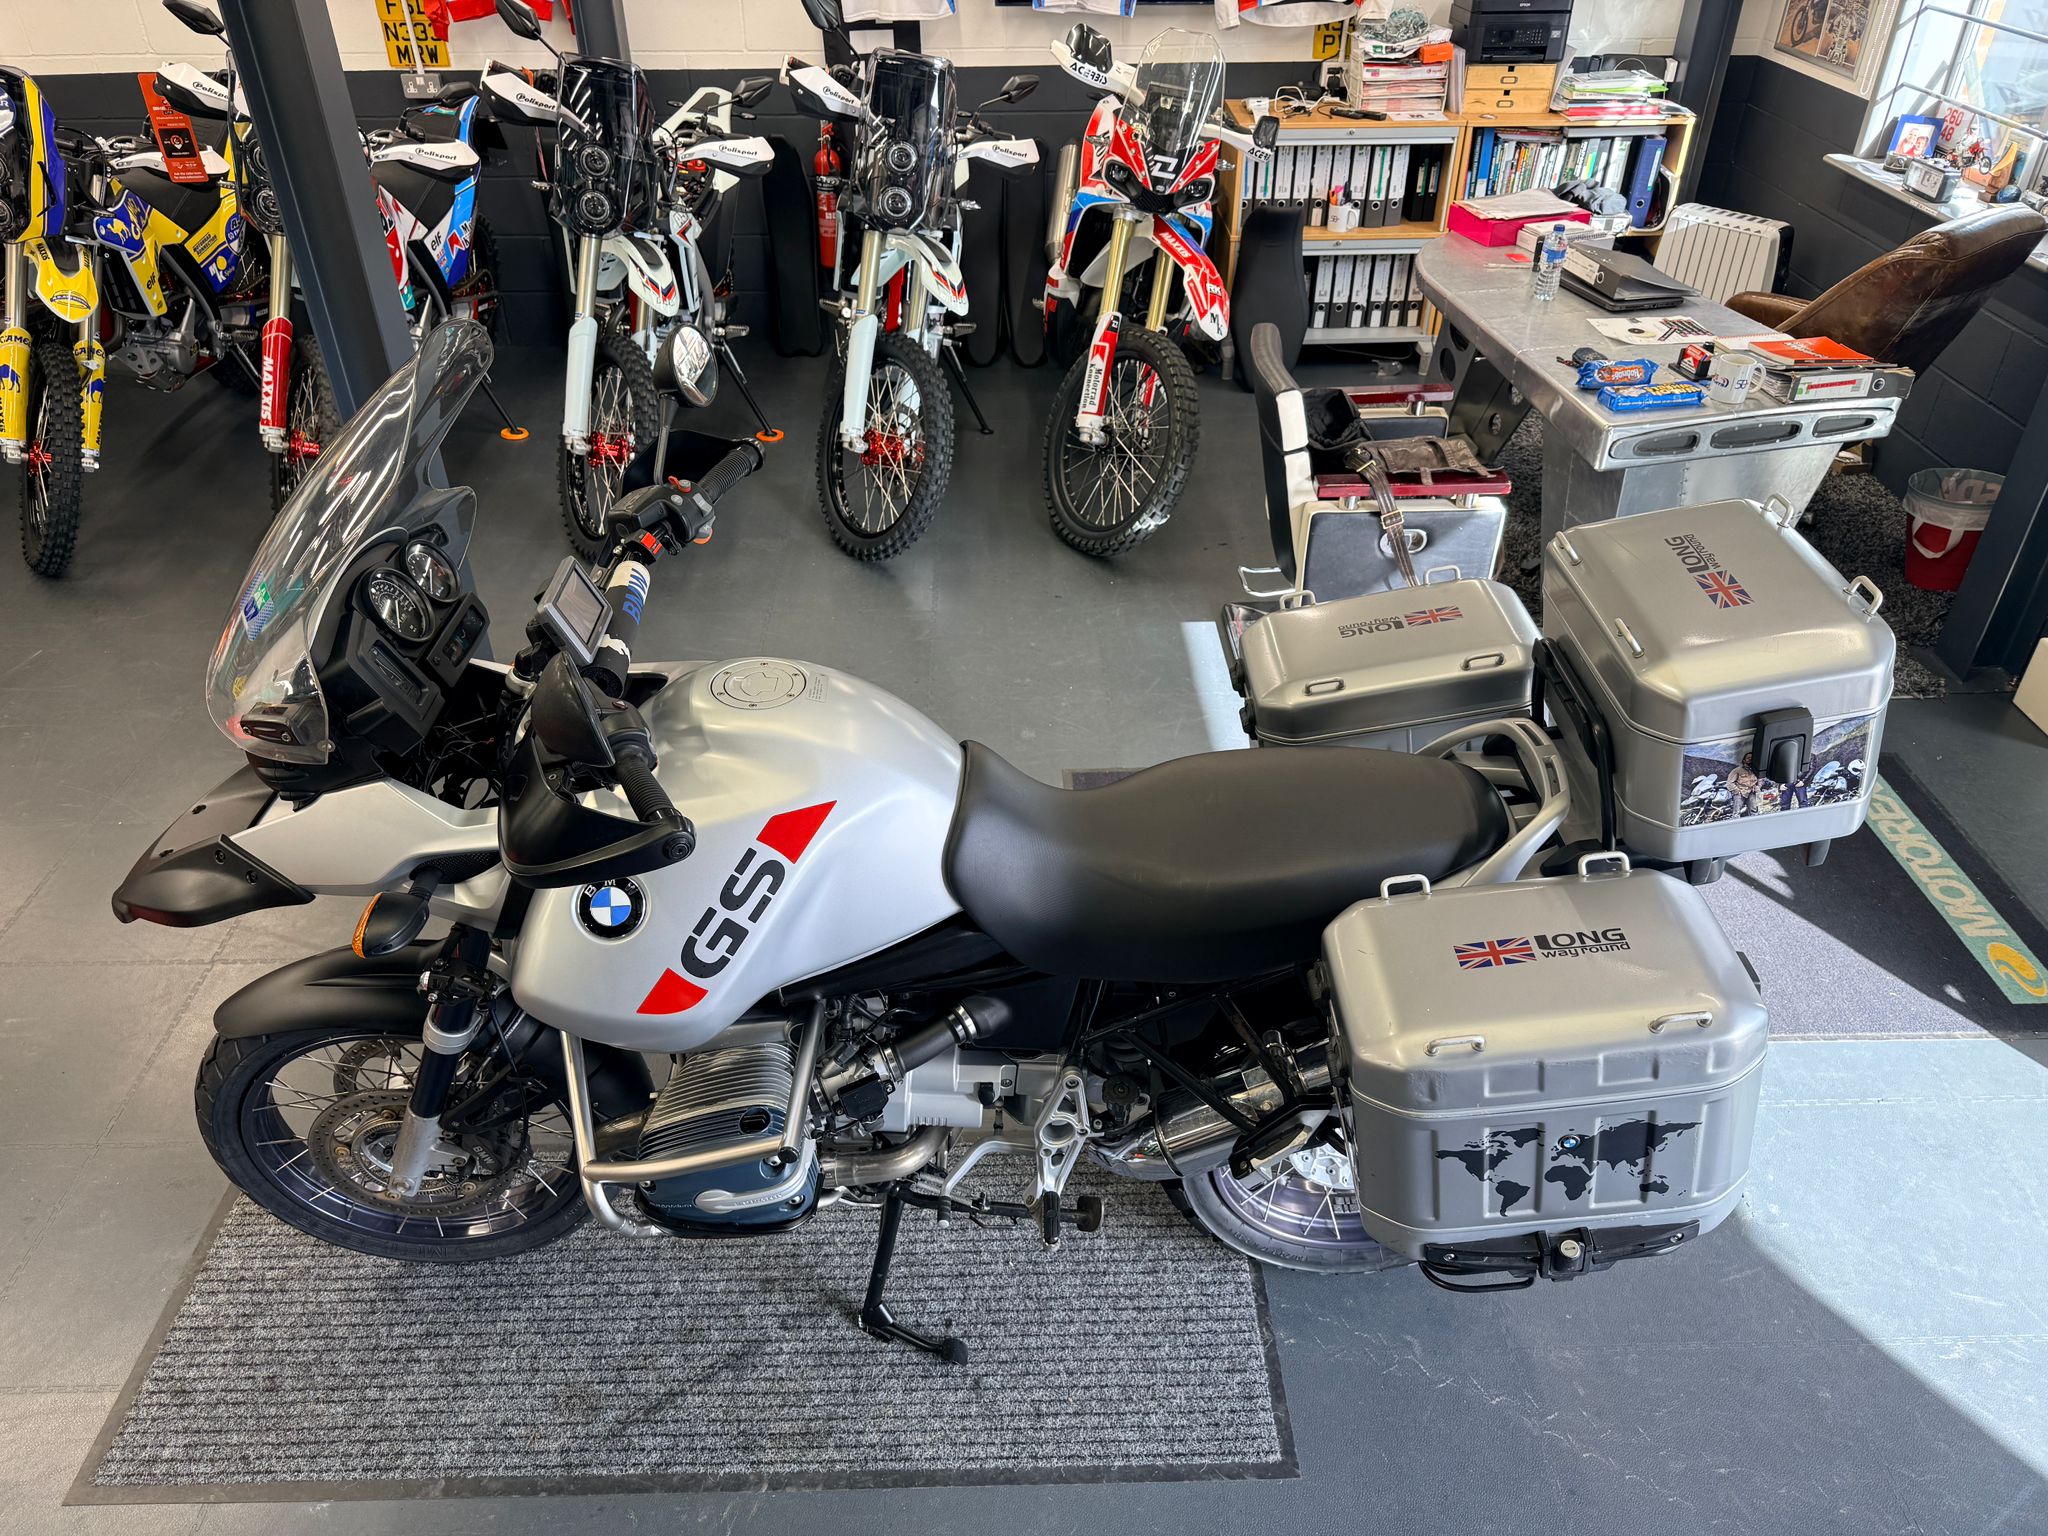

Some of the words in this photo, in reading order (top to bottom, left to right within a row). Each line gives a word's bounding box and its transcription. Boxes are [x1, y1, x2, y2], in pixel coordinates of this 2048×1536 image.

[1069, 61, 1108, 85] ACERBIS
[516, 92, 556, 110] Polisport
[823, 86, 855, 105] Polisport
[1943, 107, 1965, 128] 260
[415, 147, 457, 161] Polisport
[718, 143, 758, 157] Polisport
[992, 144, 1028, 158] Polisport
[430, 231, 442, 252] elf
[1159, 231, 1192, 260] MAXXIS
[146, 271, 157, 290] elf
[260, 355, 275, 421] MAXXIS
[1081, 363, 1096, 409] Konnection
[1088, 368, 1103, 407] Motorrad
[1664, 535, 1710, 574] LONG
[623, 567, 648, 625] BMW
[1340, 620, 1405, 639] LONG
[1868, 782, 2009, 938] MOTORE
[584, 878, 639, 898] BMW
[680, 847, 786, 979] GS
[1533, 927, 1627, 951] LONG
[472, 1145, 496, 1166] BMW
